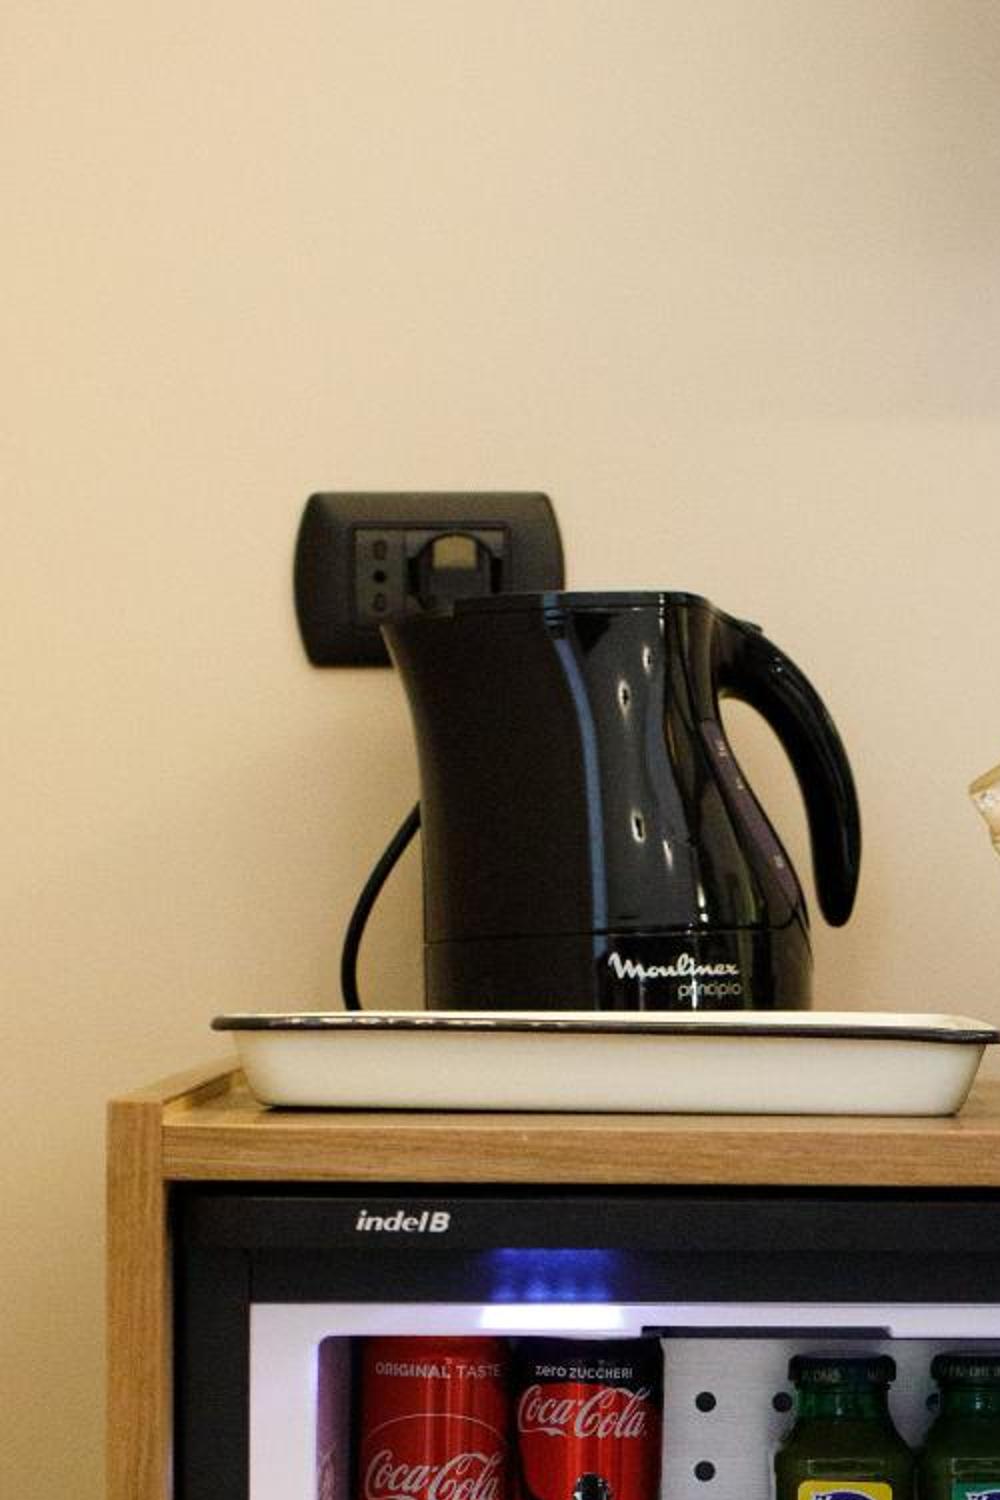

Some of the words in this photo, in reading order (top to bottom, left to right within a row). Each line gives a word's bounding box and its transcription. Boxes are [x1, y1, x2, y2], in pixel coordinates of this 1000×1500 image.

[608, 952, 740, 979] Moulinex
[375, 1361, 451, 1379] ORIGINAL
[456, 1364, 502, 1379] TASTE
[569, 1366, 633, 1380] ZUCCHERI
[518, 1384, 651, 1438] Coca-Cola
